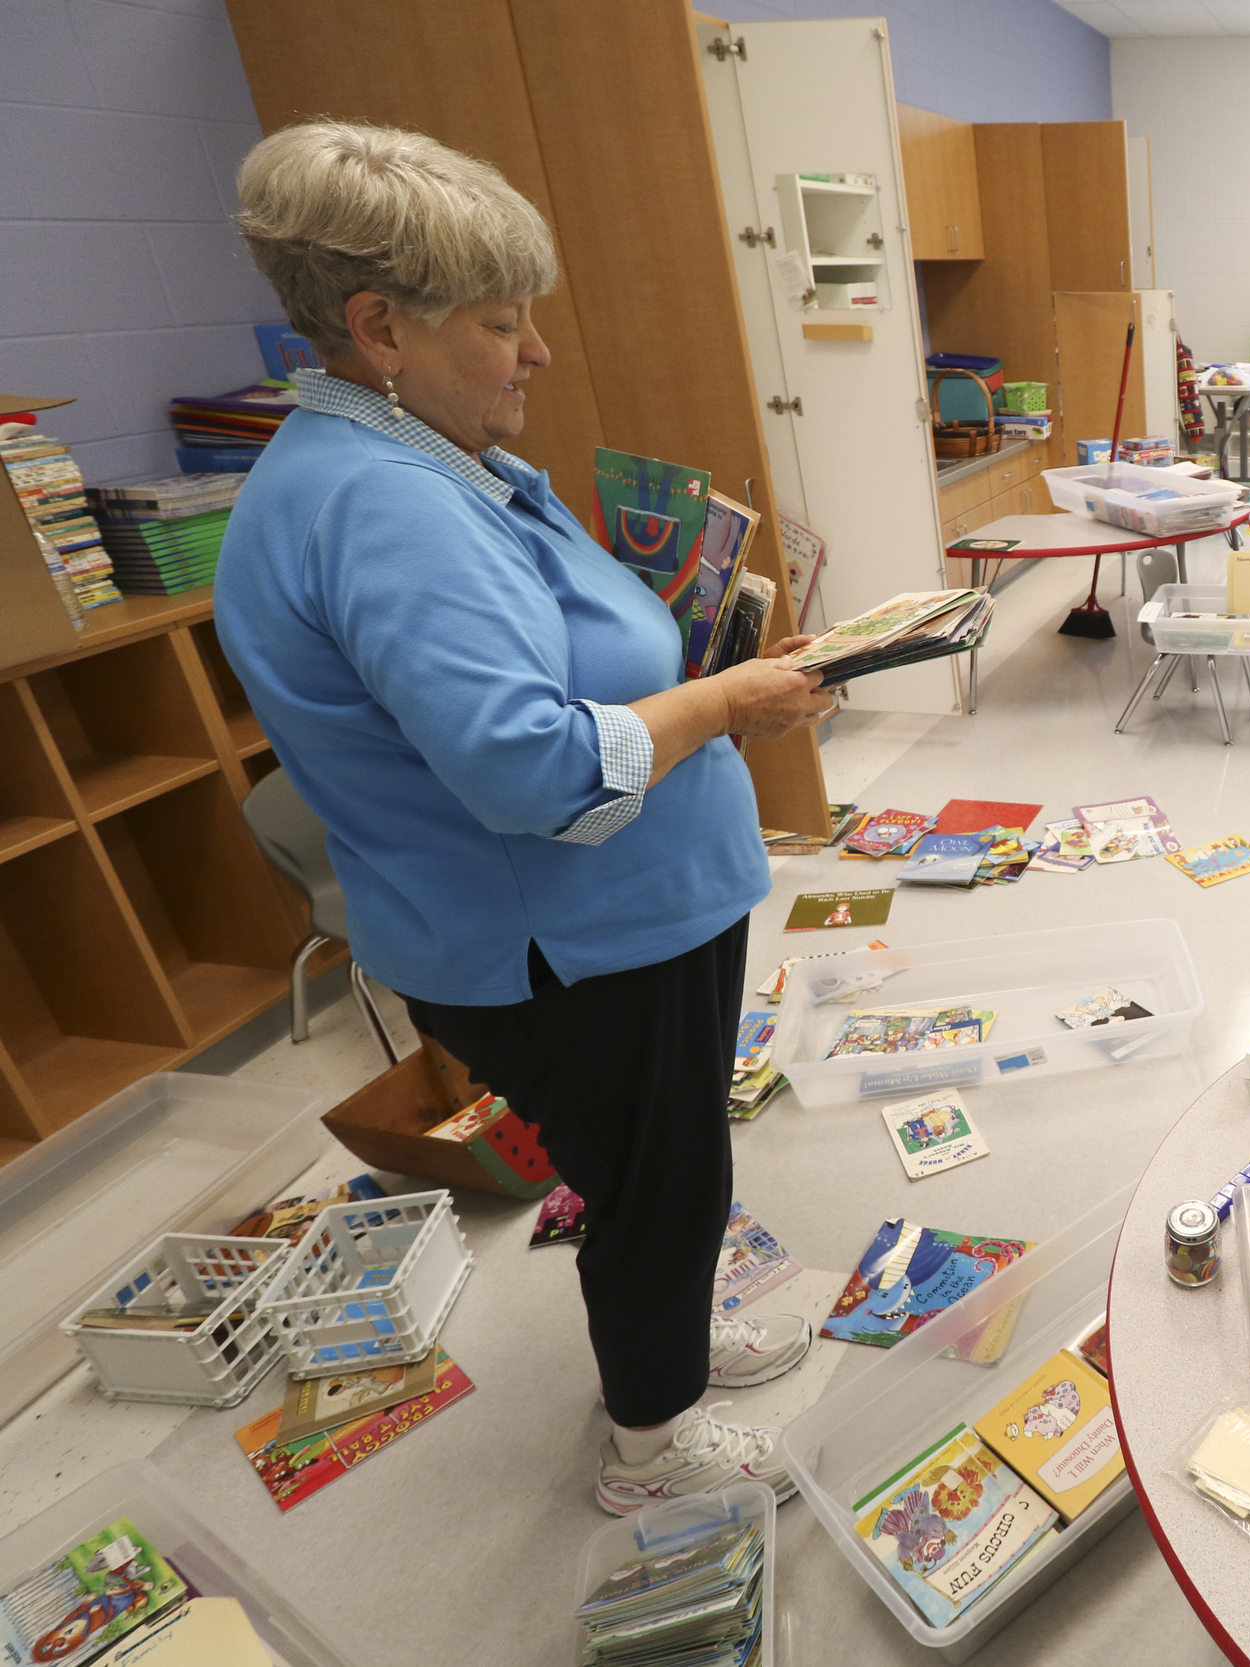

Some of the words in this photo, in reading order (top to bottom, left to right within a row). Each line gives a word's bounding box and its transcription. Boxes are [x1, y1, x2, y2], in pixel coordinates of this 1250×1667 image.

[740, 1020, 764, 1047] Phonics
[915, 1258, 958, 1304] Commotion
[941, 1289, 950, 1298] in
[952, 1275, 965, 1289] the
[948, 1275, 976, 1304] Ocean
[401, 1380, 452, 1419] PLAYS
[352, 1405, 434, 1463] FROGGY
[1089, 1418, 1114, 1443] Dainty
[1053, 1440, 1090, 1478] Dinosaur?
[1094, 1434, 1116, 1457] When
[1077, 1452, 1096, 1472] Will
[978, 1512, 1015, 1565] CIRCUS
[950, 1565, 983, 1595] FUN
